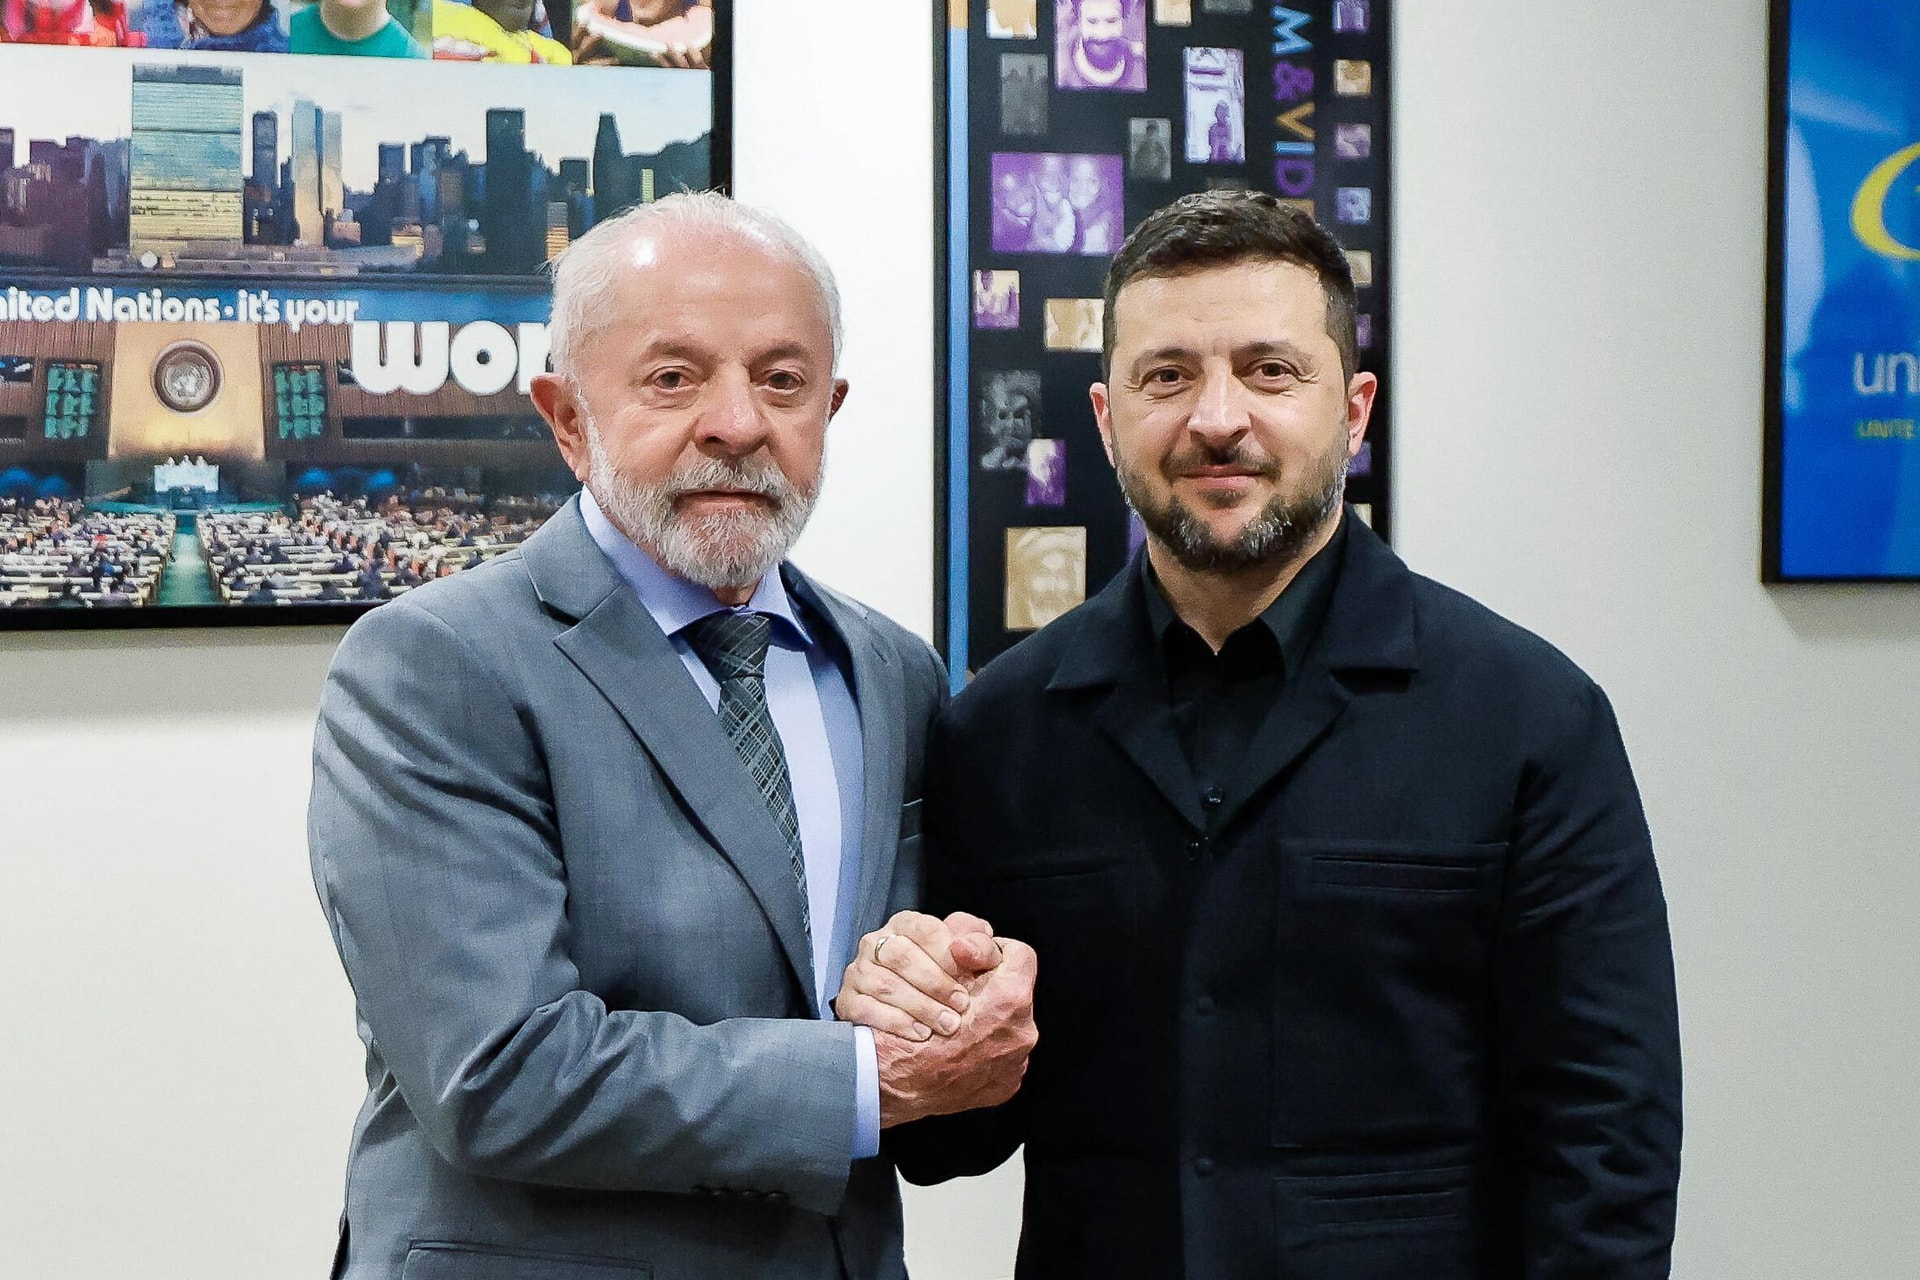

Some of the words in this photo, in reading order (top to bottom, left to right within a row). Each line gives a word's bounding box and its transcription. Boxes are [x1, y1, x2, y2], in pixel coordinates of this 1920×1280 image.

[86, 287, 220, 322] Nations
[237, 289, 280, 323] it's
[286, 299, 359, 332] your
[1854, 352, 1920, 393] un
